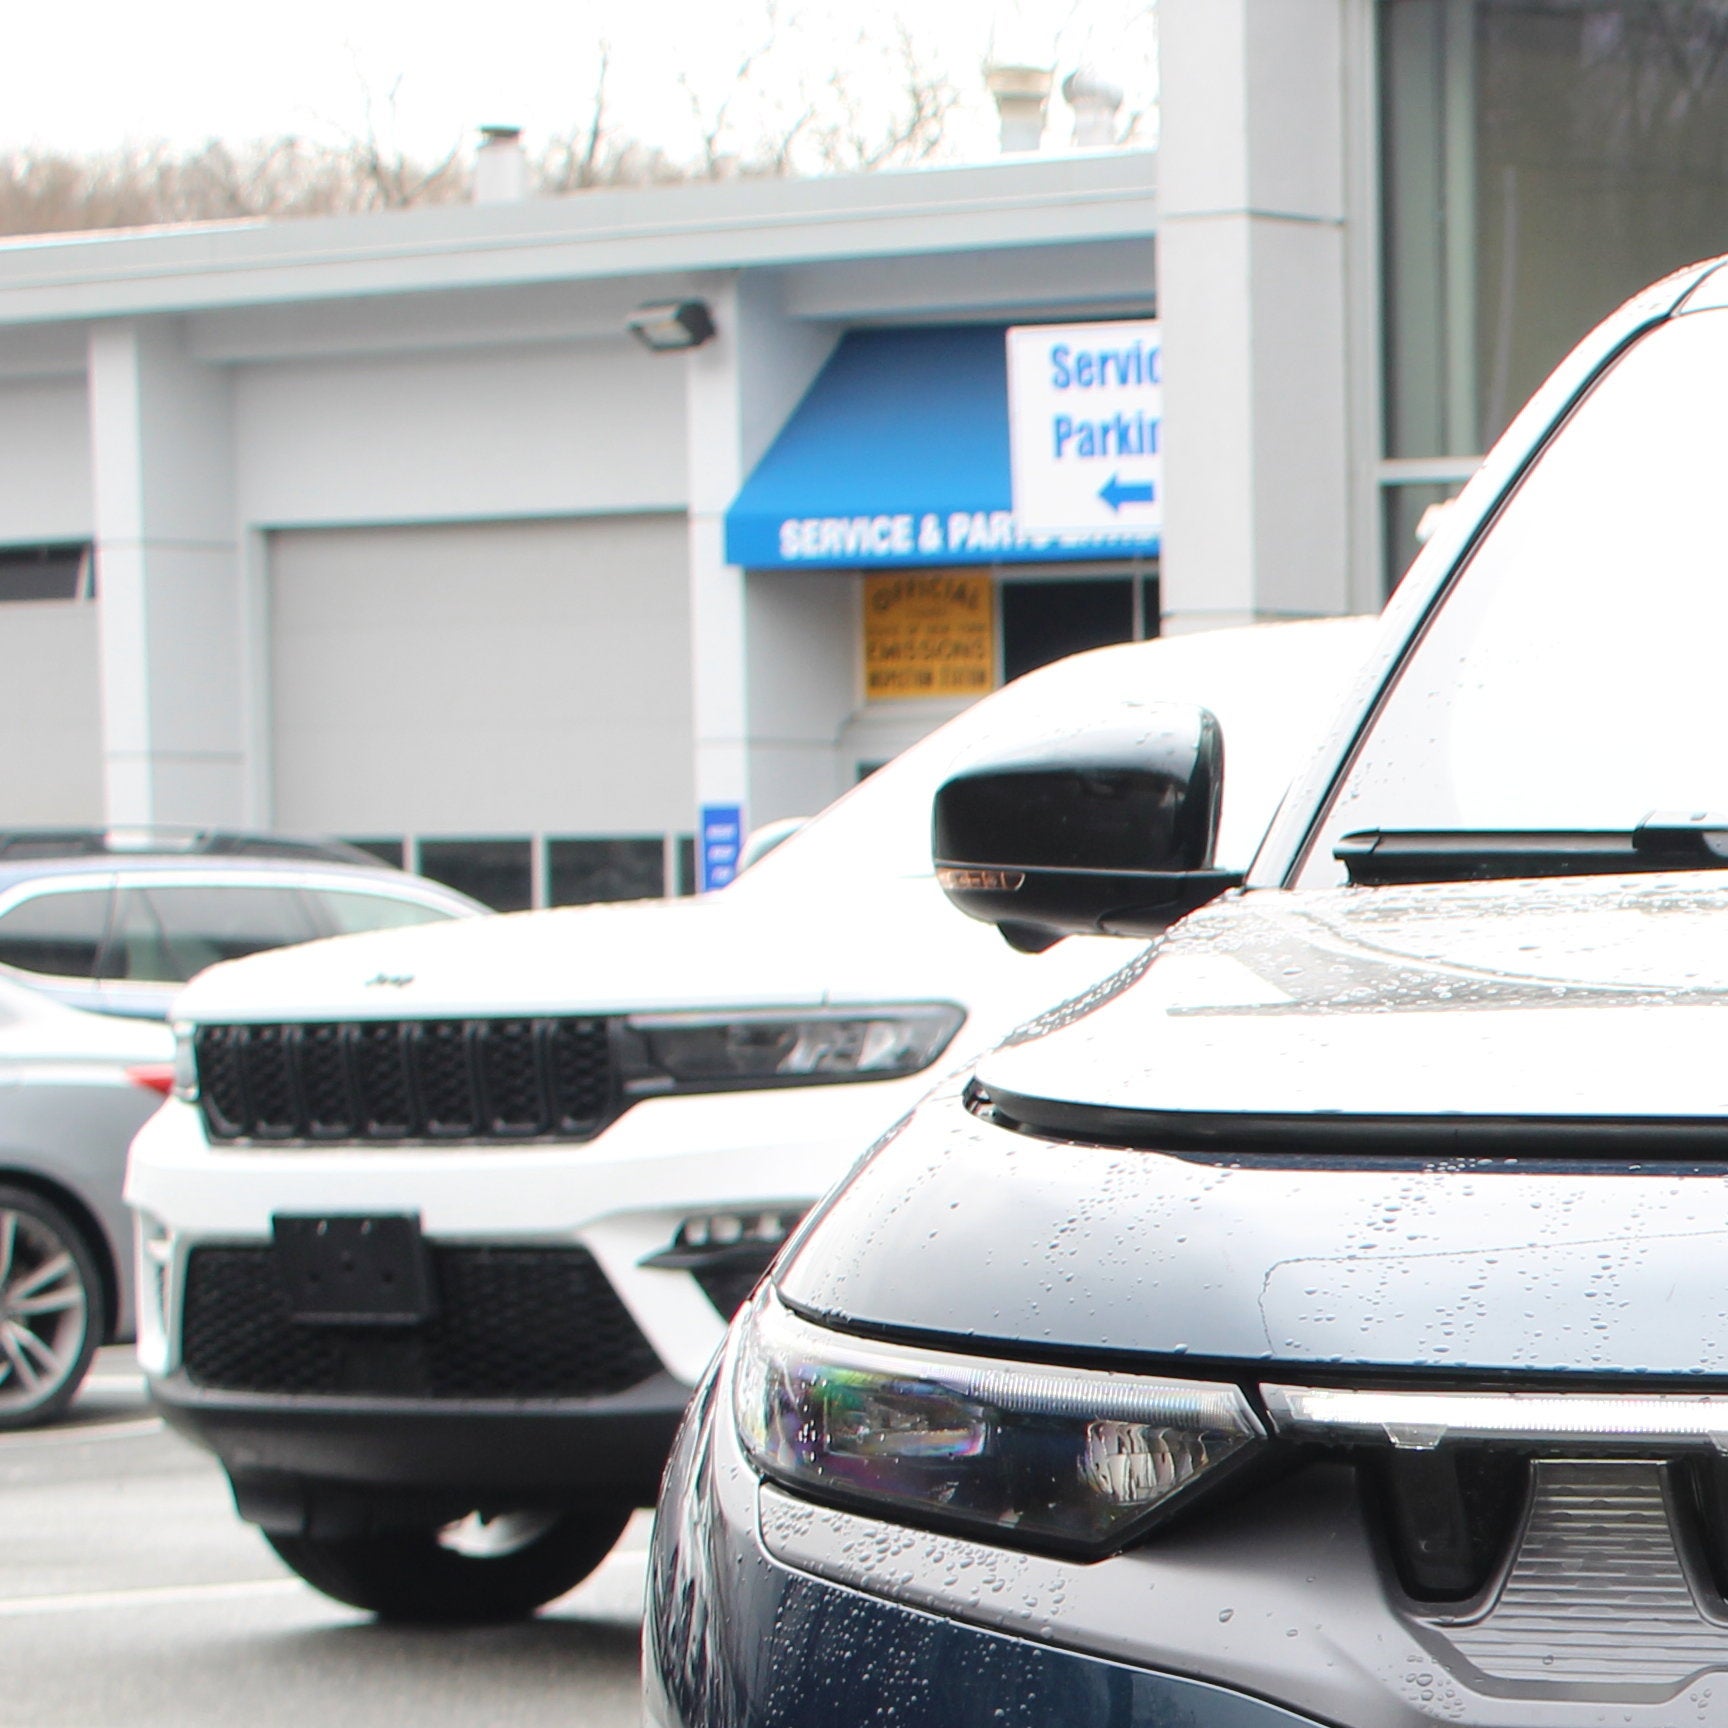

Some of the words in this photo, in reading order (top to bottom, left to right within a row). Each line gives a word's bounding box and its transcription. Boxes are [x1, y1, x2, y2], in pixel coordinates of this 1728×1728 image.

[1050, 341, 1161, 389] Servic
[780, 514, 914, 559] SERVICE
[919, 513, 943, 555] &
